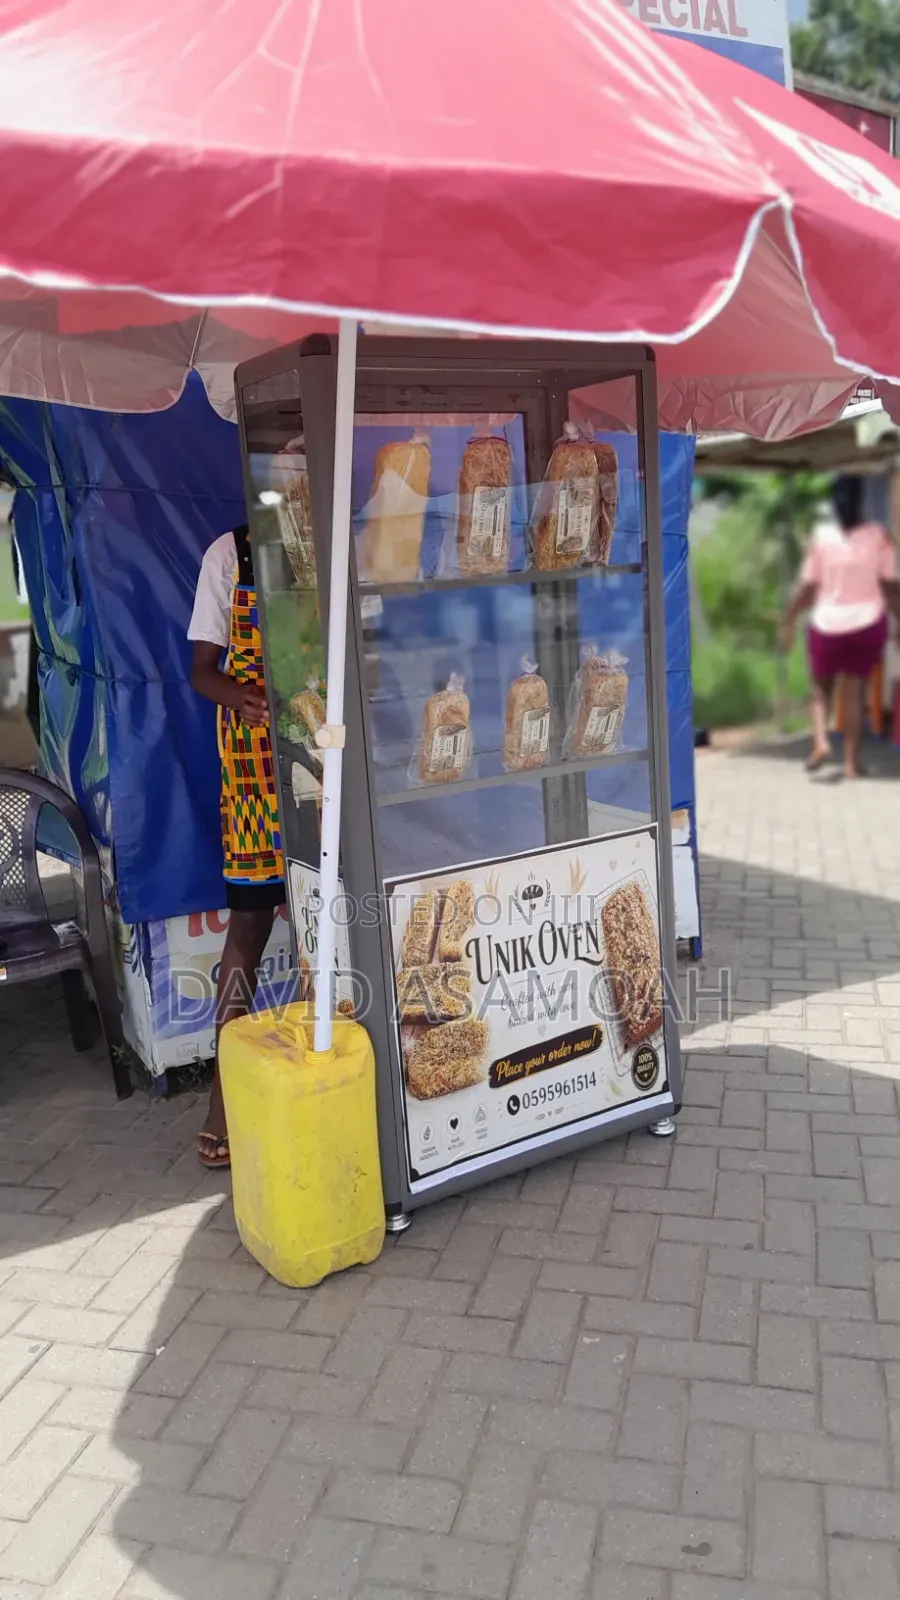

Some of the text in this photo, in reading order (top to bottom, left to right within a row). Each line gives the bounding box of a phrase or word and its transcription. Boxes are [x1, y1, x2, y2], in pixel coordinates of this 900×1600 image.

[622, 0, 748, 37] ECIAL
[465, 919, 605, 985] UNIK OVEN
[496, 1029, 596, 1082] Place your order now!
[522, 1071, 597, 1109] 0595961514
